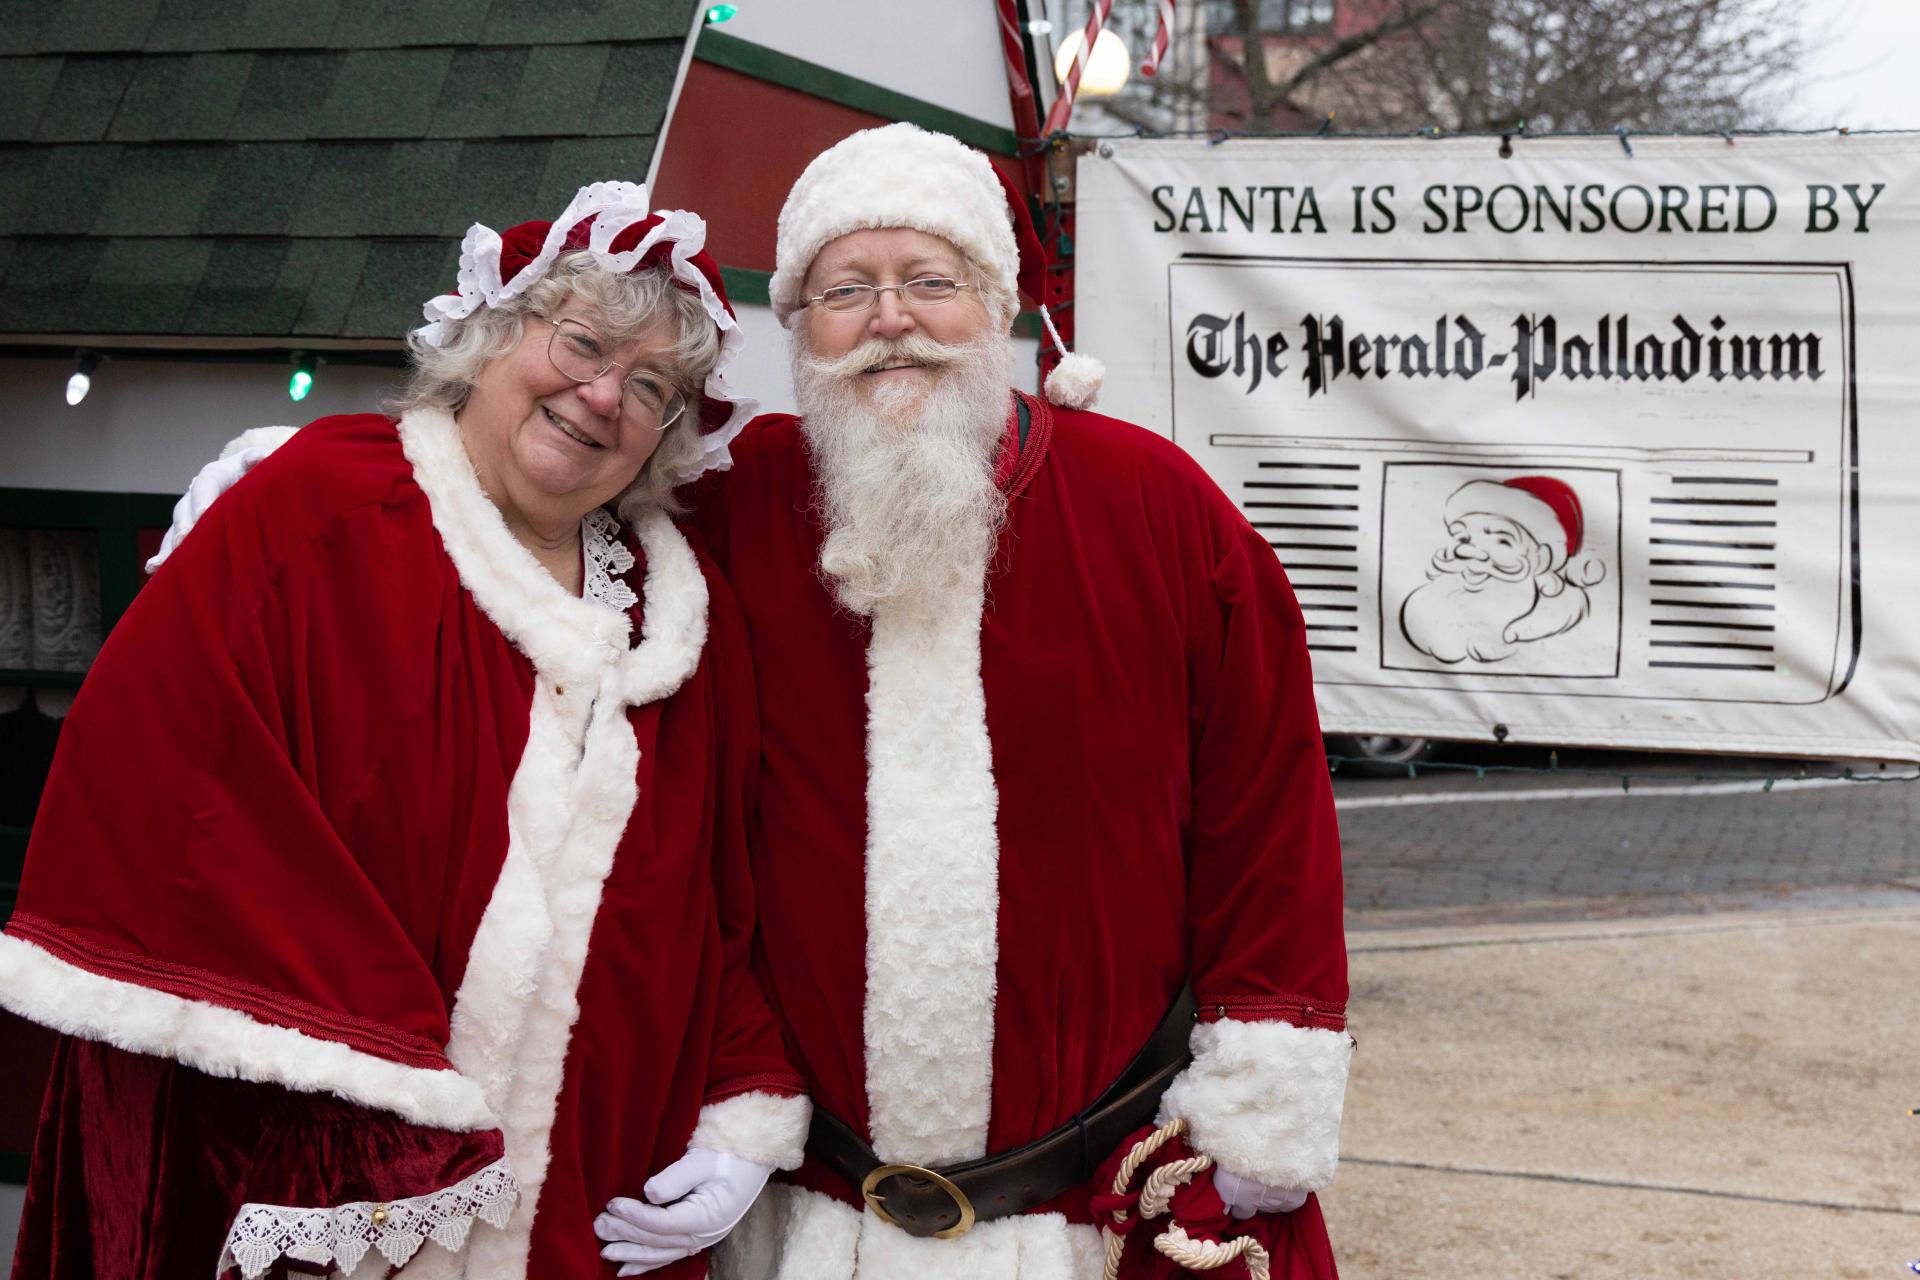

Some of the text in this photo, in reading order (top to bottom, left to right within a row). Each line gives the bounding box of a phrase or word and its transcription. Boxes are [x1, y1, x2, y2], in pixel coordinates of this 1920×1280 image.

[1152, 184, 1885, 234] SANTA IS SPONSORED BY
[1186, 311, 1824, 402] The Herald-Palladium
